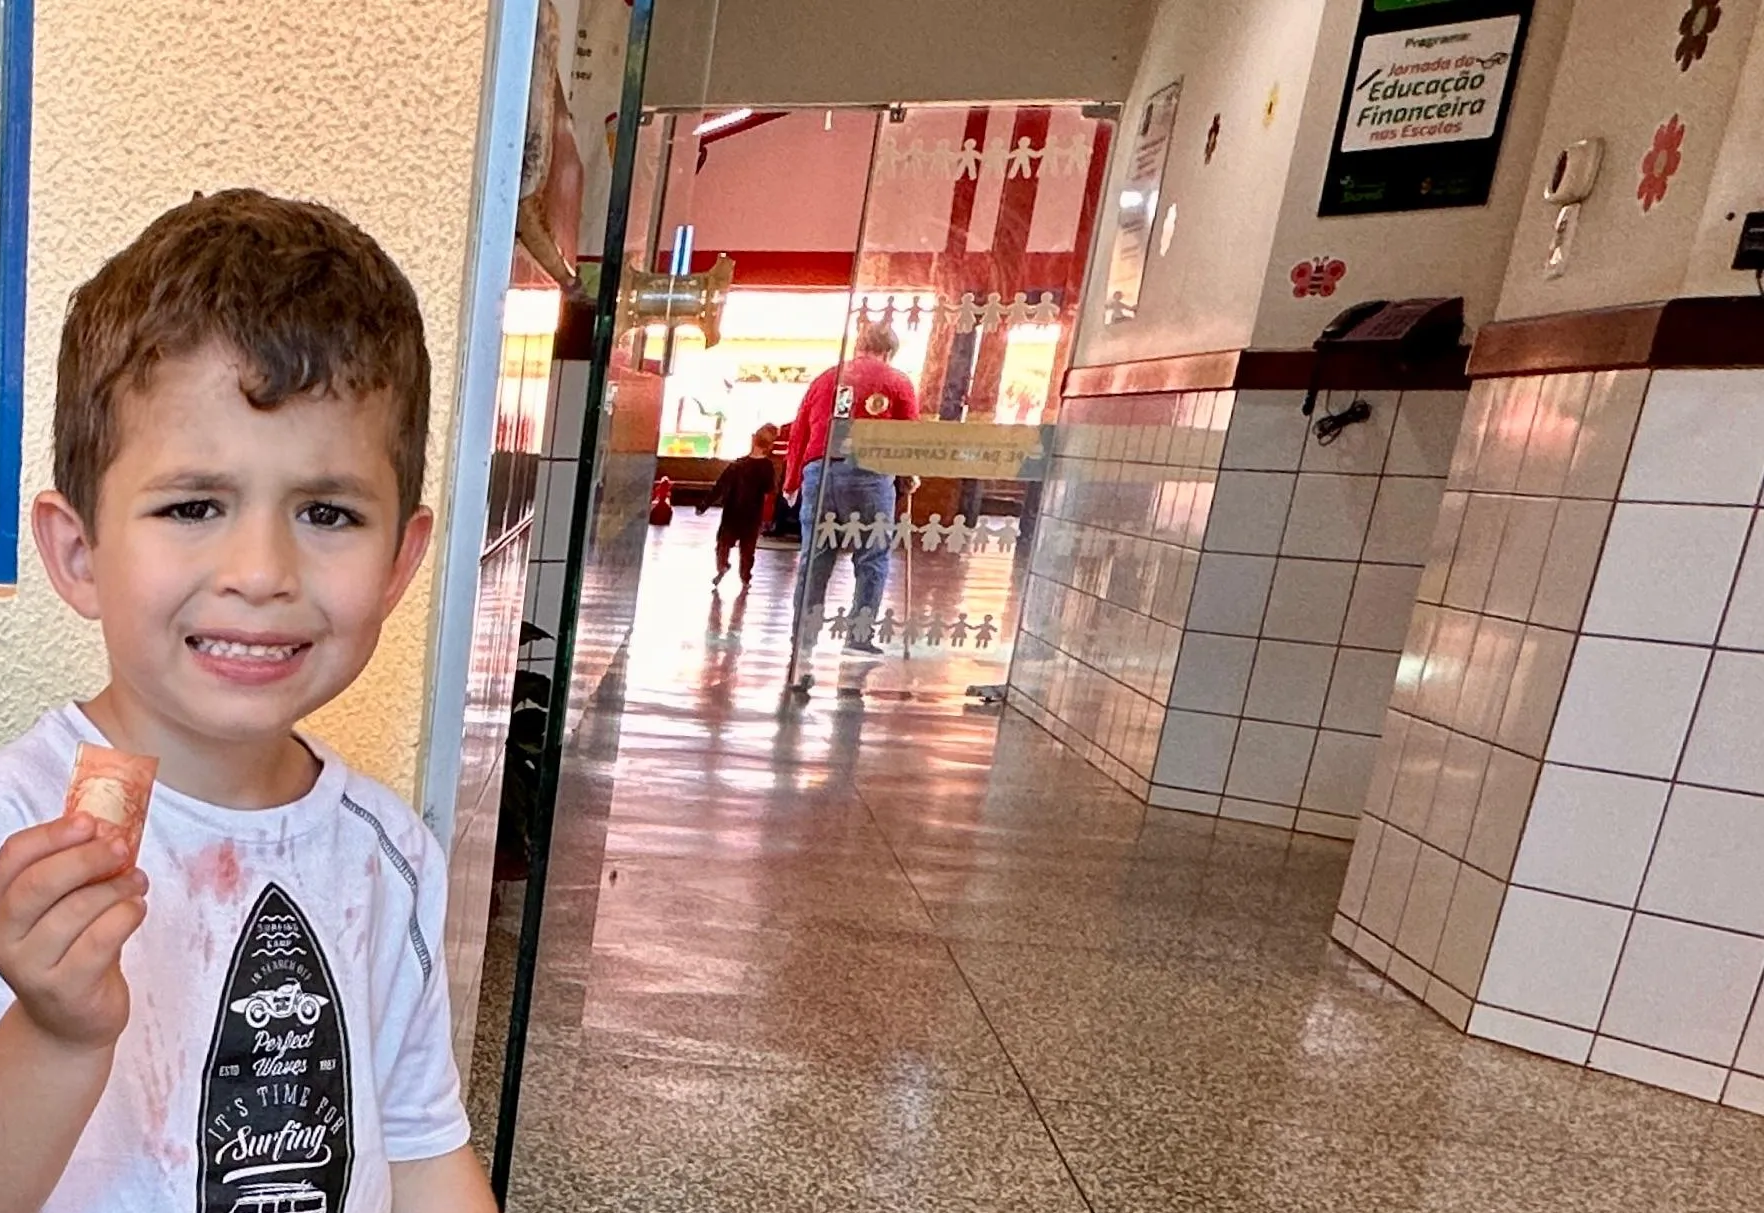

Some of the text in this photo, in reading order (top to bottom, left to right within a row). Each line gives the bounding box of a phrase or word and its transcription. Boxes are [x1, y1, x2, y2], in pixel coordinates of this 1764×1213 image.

[1387, 55, 1452, 78] Jornada
[1368, 70, 1485, 102] Educação
[1357, 97, 1486, 127] Financeira
[1369, 120, 1463, 142] nas Escolas
[252, 1028, 317, 1056] Perfect
[251, 1056, 309, 1077] Waves
[256, 1084, 312, 1108] TIME
[315, 1096, 345, 1135] FOR
[216, 1119, 331, 1164] Surfing
